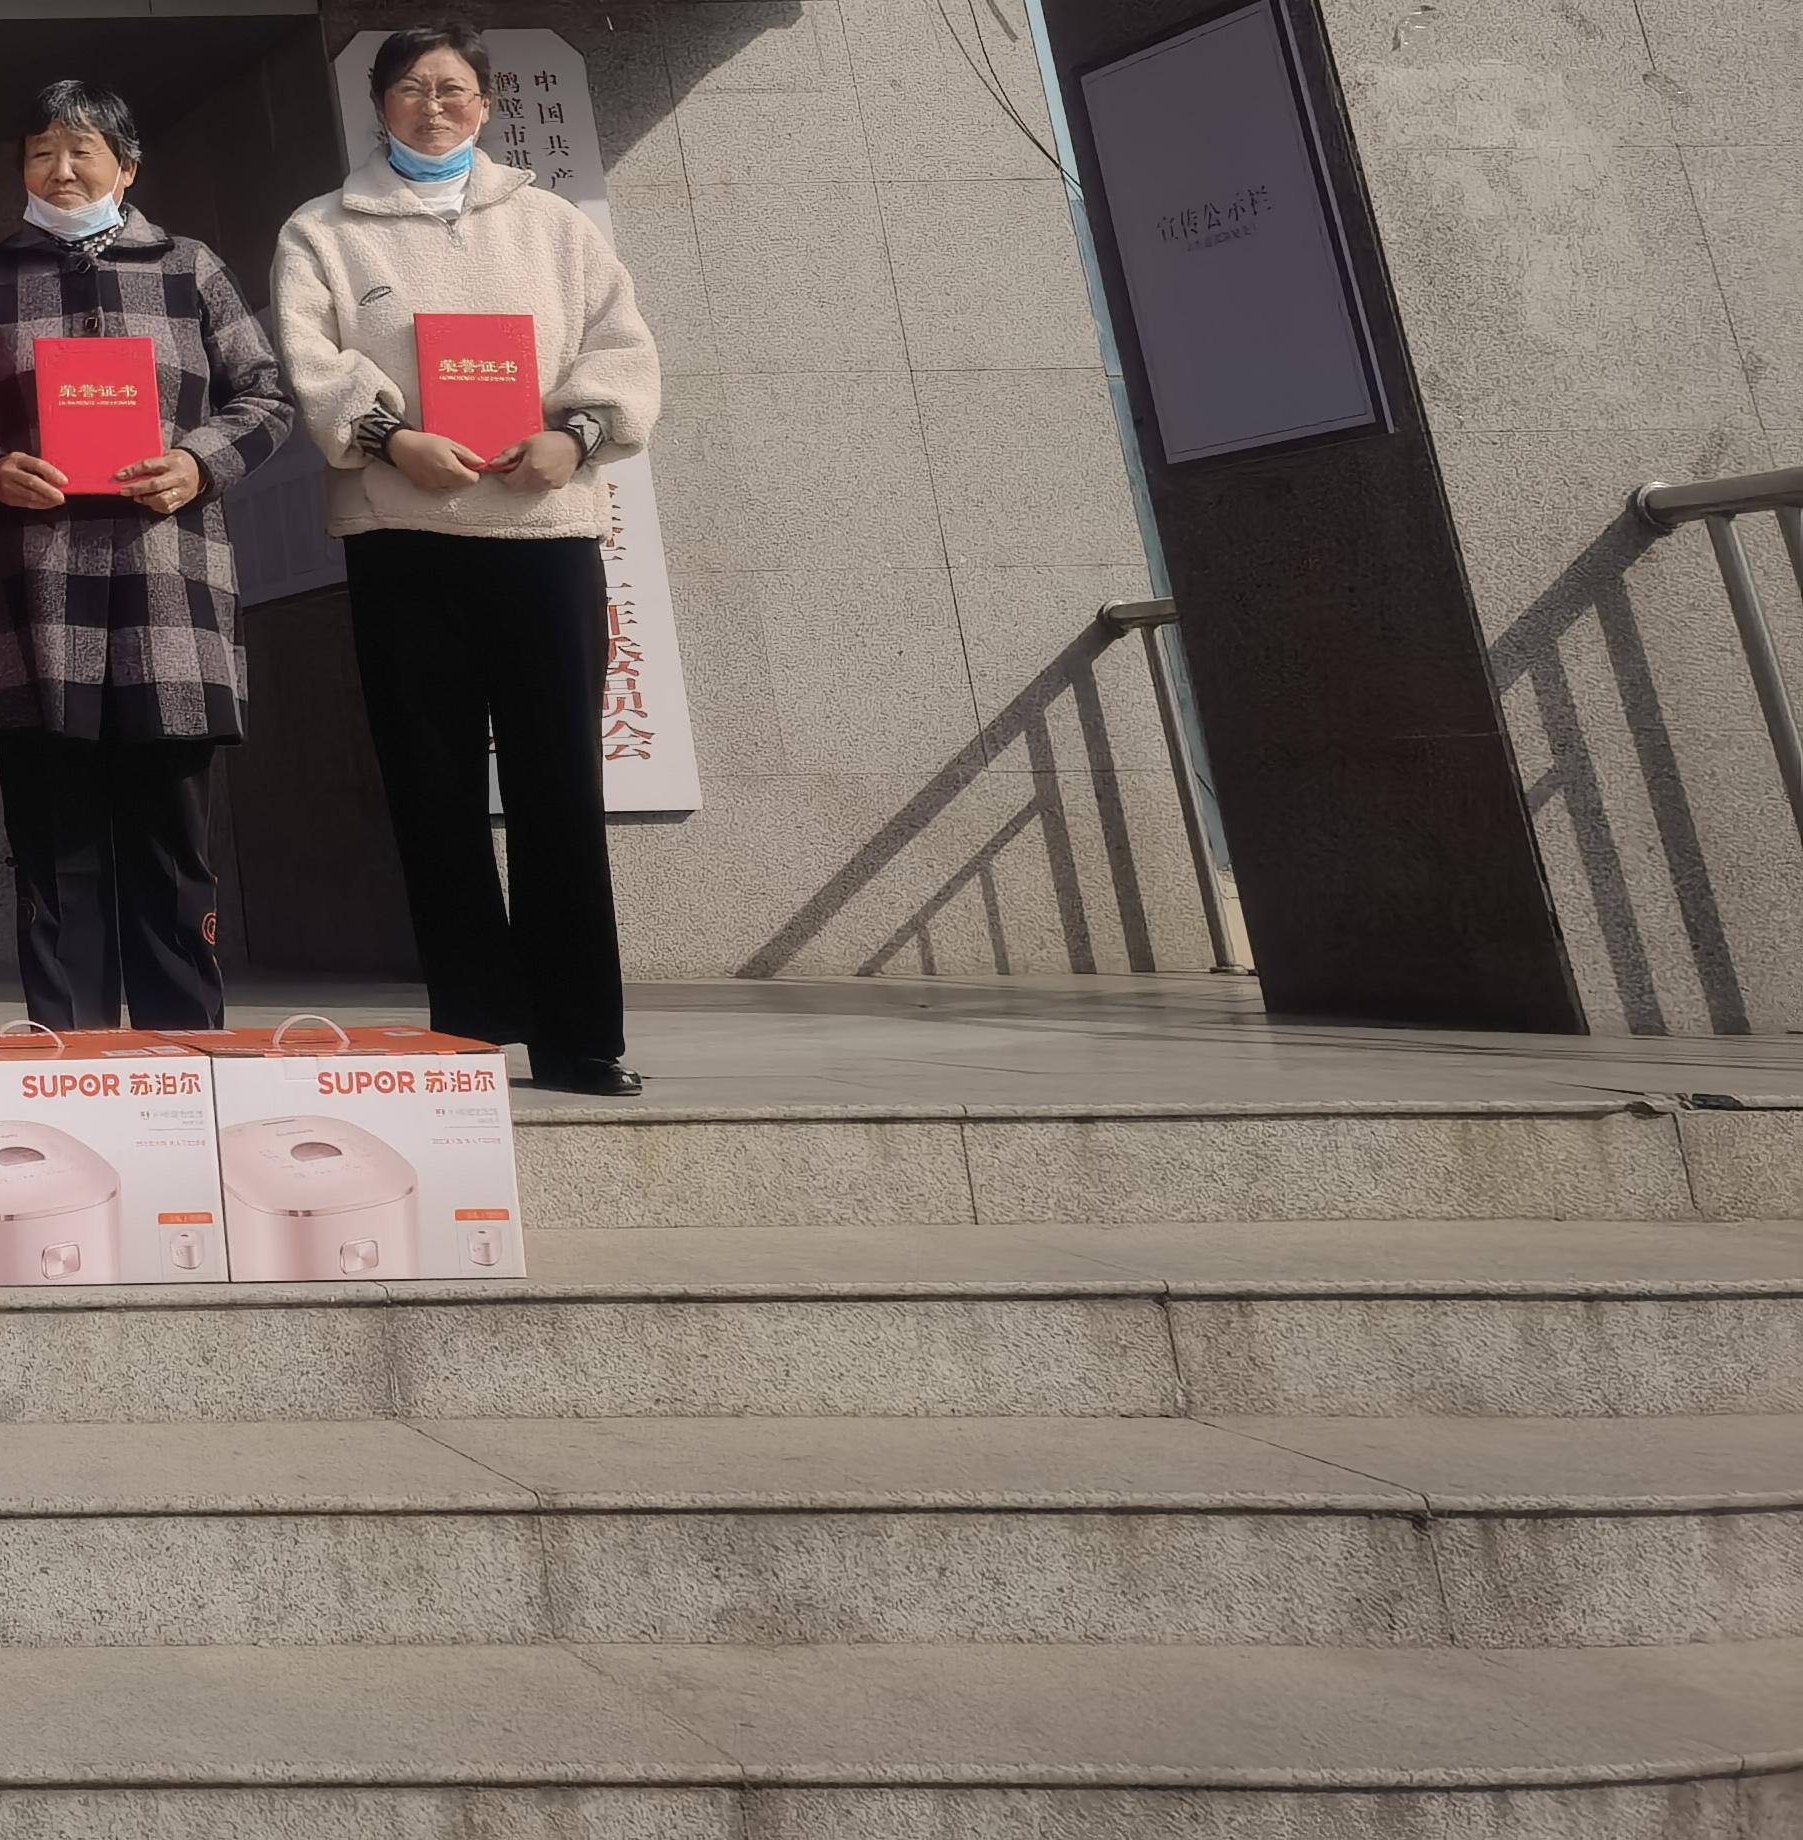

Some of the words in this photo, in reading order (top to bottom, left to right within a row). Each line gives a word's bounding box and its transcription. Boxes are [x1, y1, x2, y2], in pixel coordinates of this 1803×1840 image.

[534, 70, 574, 189] 中国共产
[438, 359, 518, 374] 荣誉证书
[58, 384, 138, 400] 荣誉证书
[22, 1072, 121, 1098] SUPOR
[130, 1072, 200, 1096] 苏泊尔
[318, 1071, 415, 1095] SUPOR
[424, 1070, 495, 1093] 苏泊尔
